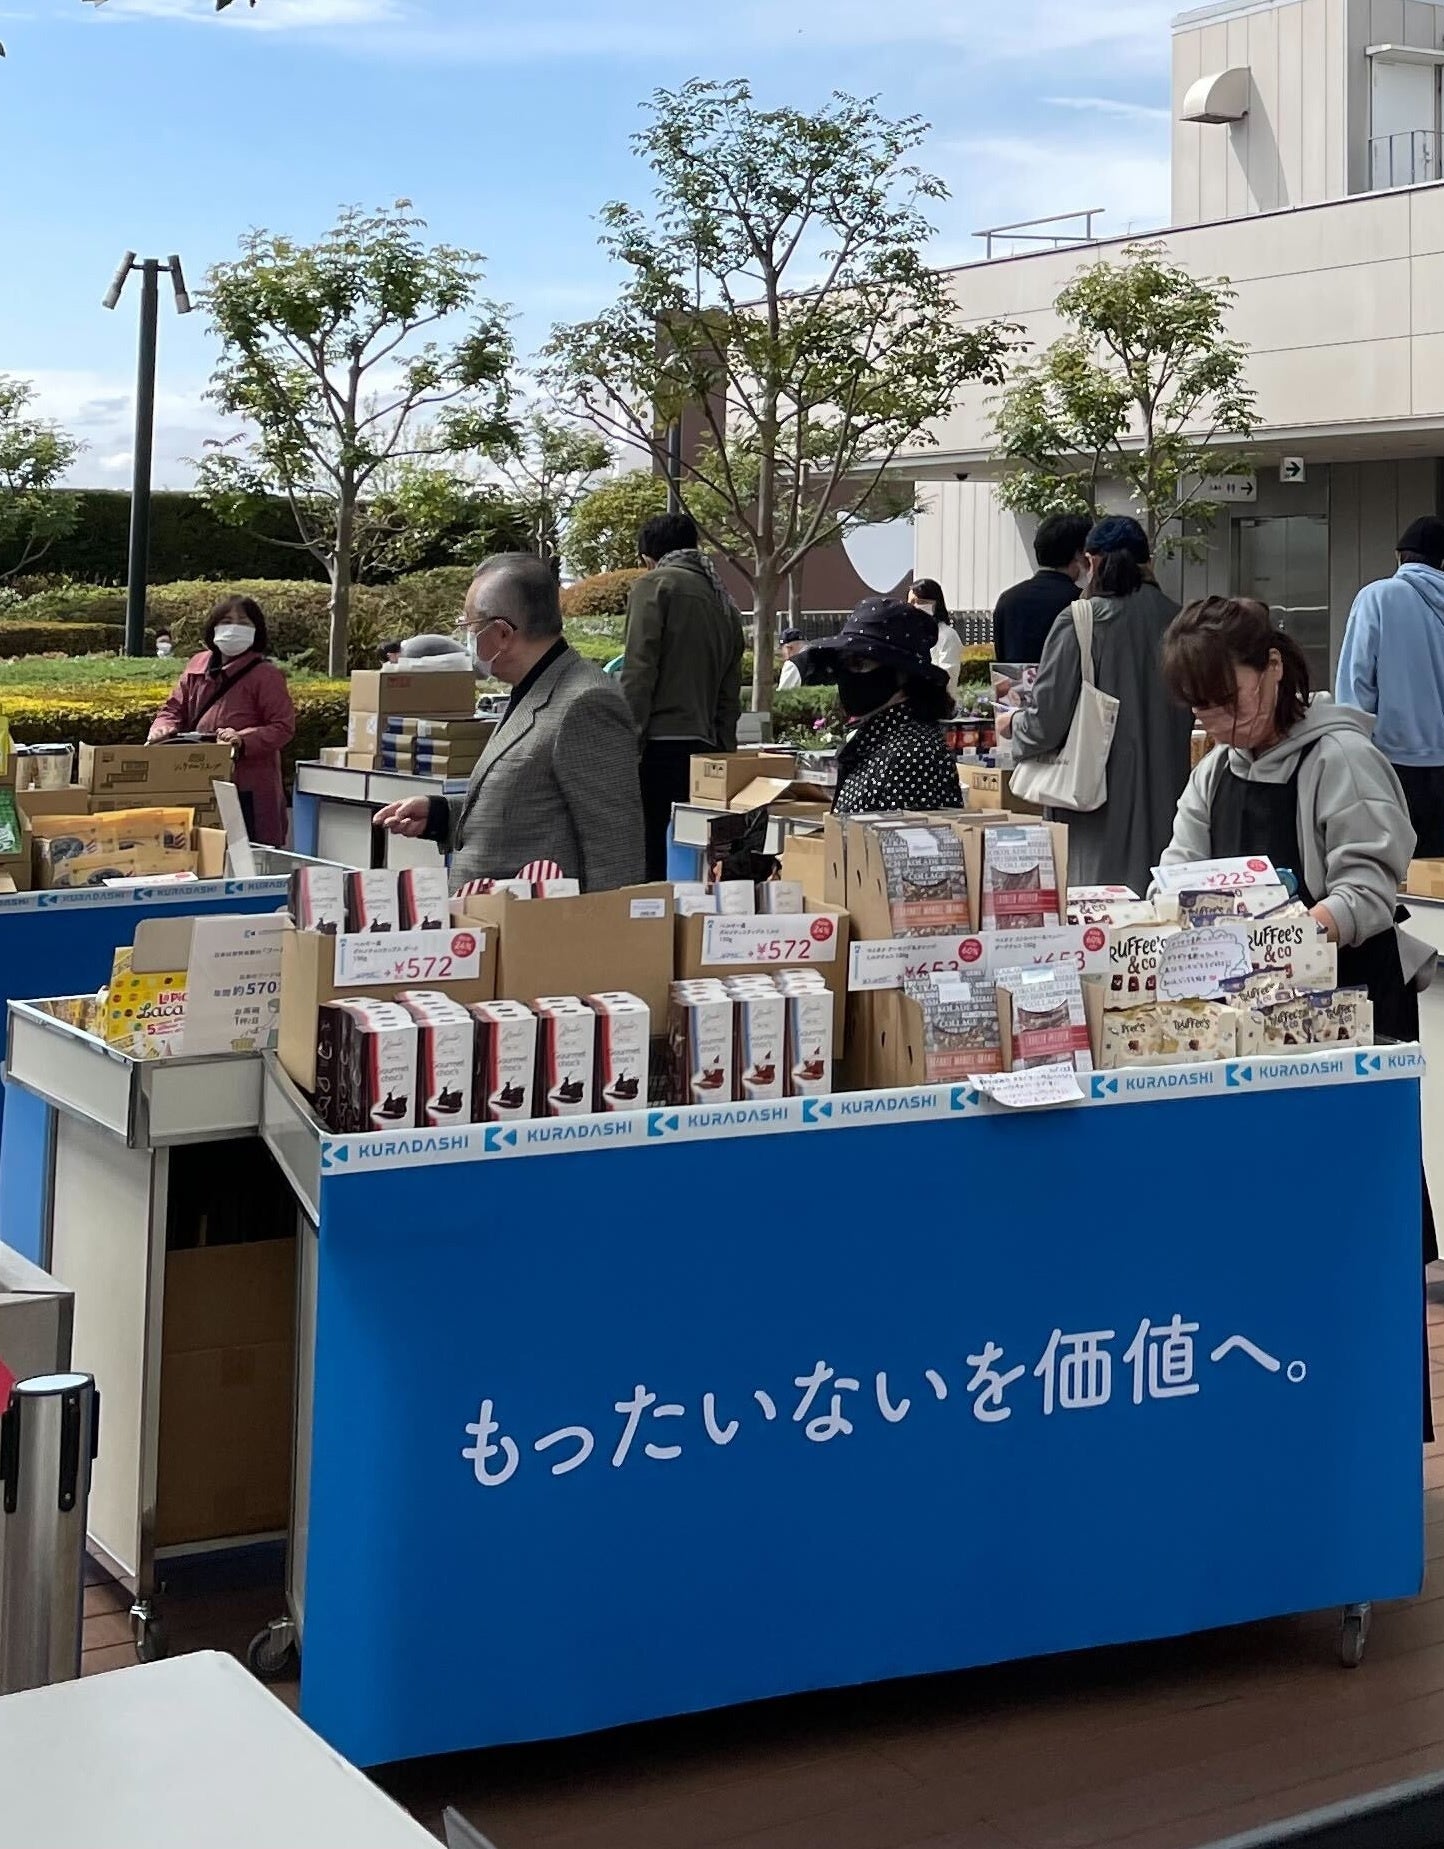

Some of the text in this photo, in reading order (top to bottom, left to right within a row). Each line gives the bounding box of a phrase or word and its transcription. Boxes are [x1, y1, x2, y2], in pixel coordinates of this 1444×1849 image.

[1207, 871, 1256, 887] ¥225
[757, 939, 811, 960] ¥572
[1110, 936, 1167, 963] RUFFee's
[1248, 925, 1303, 951] RUFFee's
[394, 955, 453, 979] ¥572
[135, 1002, 186, 1019] Laca
[359, 1135, 469, 1158] KURADASHI
[527, 1121, 632, 1143] KURADASHI
[688, 1107, 788, 1127] KURADASHI
[841, 1094, 936, 1115] KURADASHI
[1126, 1071, 1214, 1090] KURADASHI
[1259, 1060, 1343, 1078] KURADASHI
[461, 1313, 1307, 1487] もったいないを価値へ。
